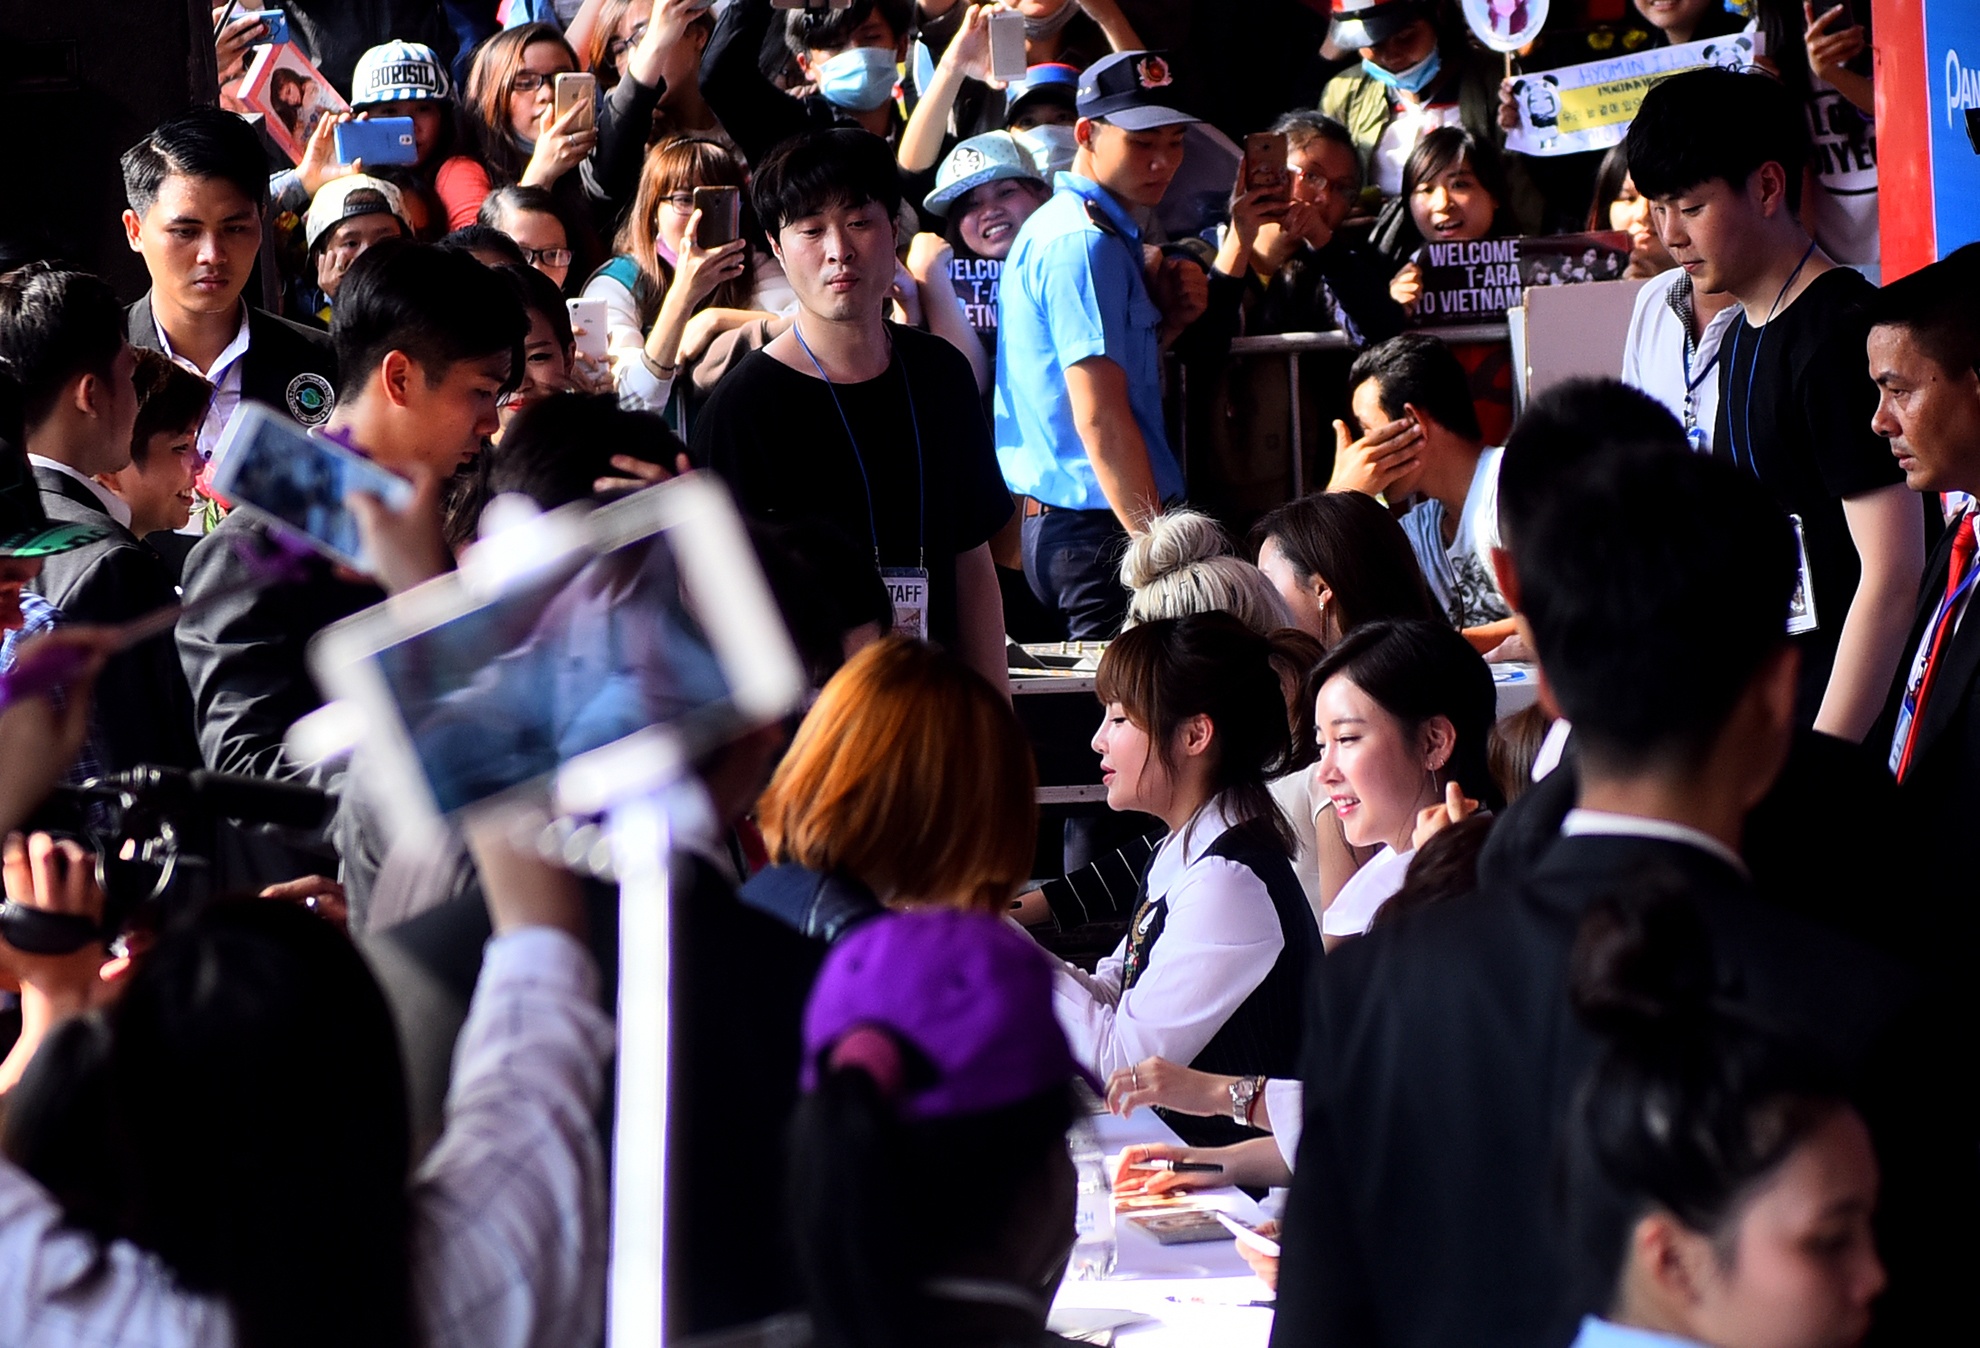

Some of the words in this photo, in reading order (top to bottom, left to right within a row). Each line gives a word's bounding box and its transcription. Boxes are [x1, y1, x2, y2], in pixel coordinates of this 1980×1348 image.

[1429, 240, 1521, 267] WELCOME
[1465, 263, 1521, 288] T-ARA
[1440, 286, 1521, 313] VIETNAM
